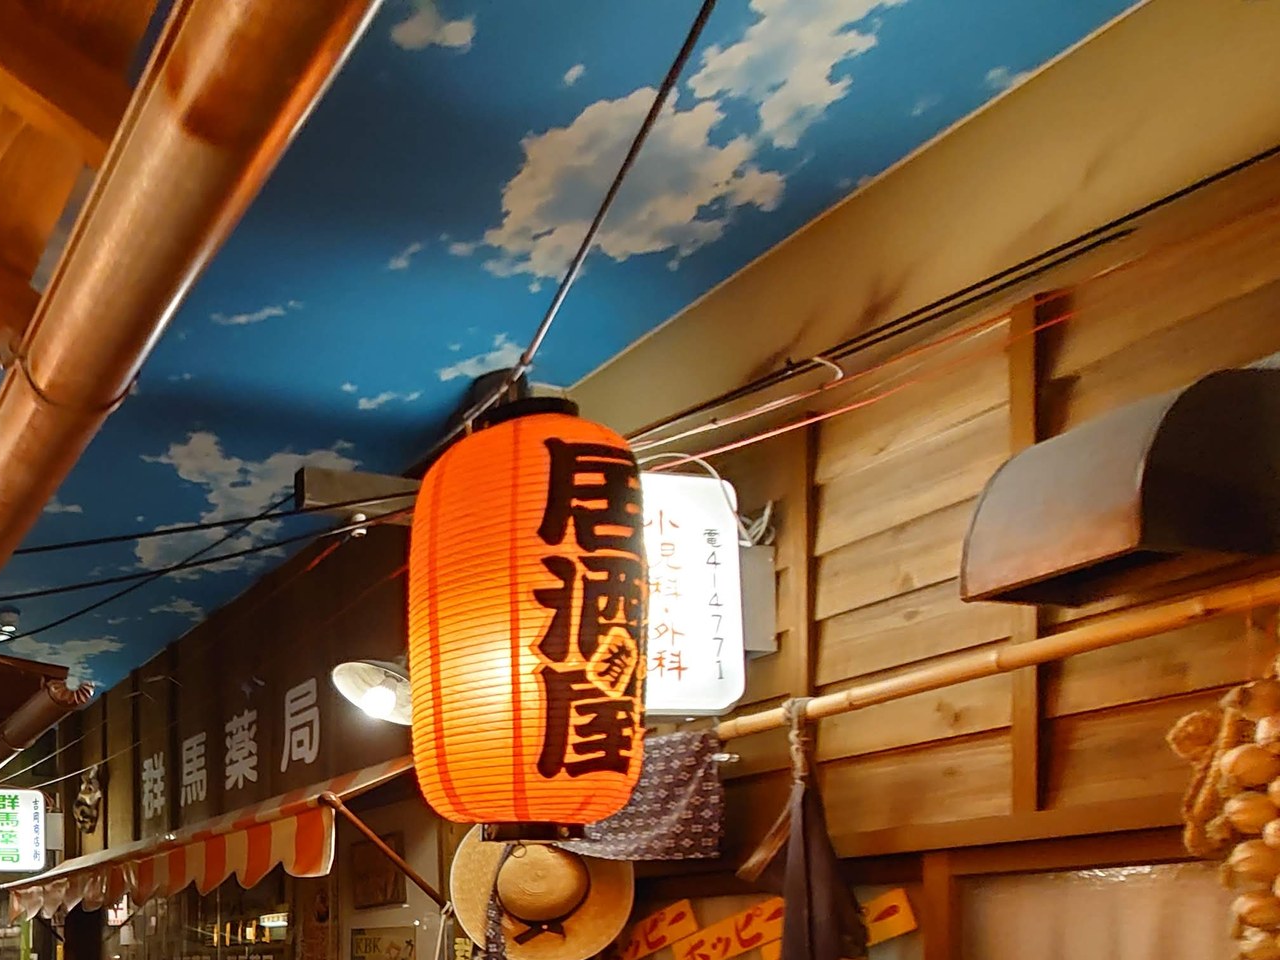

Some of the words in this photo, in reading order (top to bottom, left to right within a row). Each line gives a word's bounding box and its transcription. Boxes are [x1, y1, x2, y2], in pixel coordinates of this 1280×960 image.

[533, 438, 644, 778] 居酒屋
[141, 677, 321, 820] 群馬薬局
